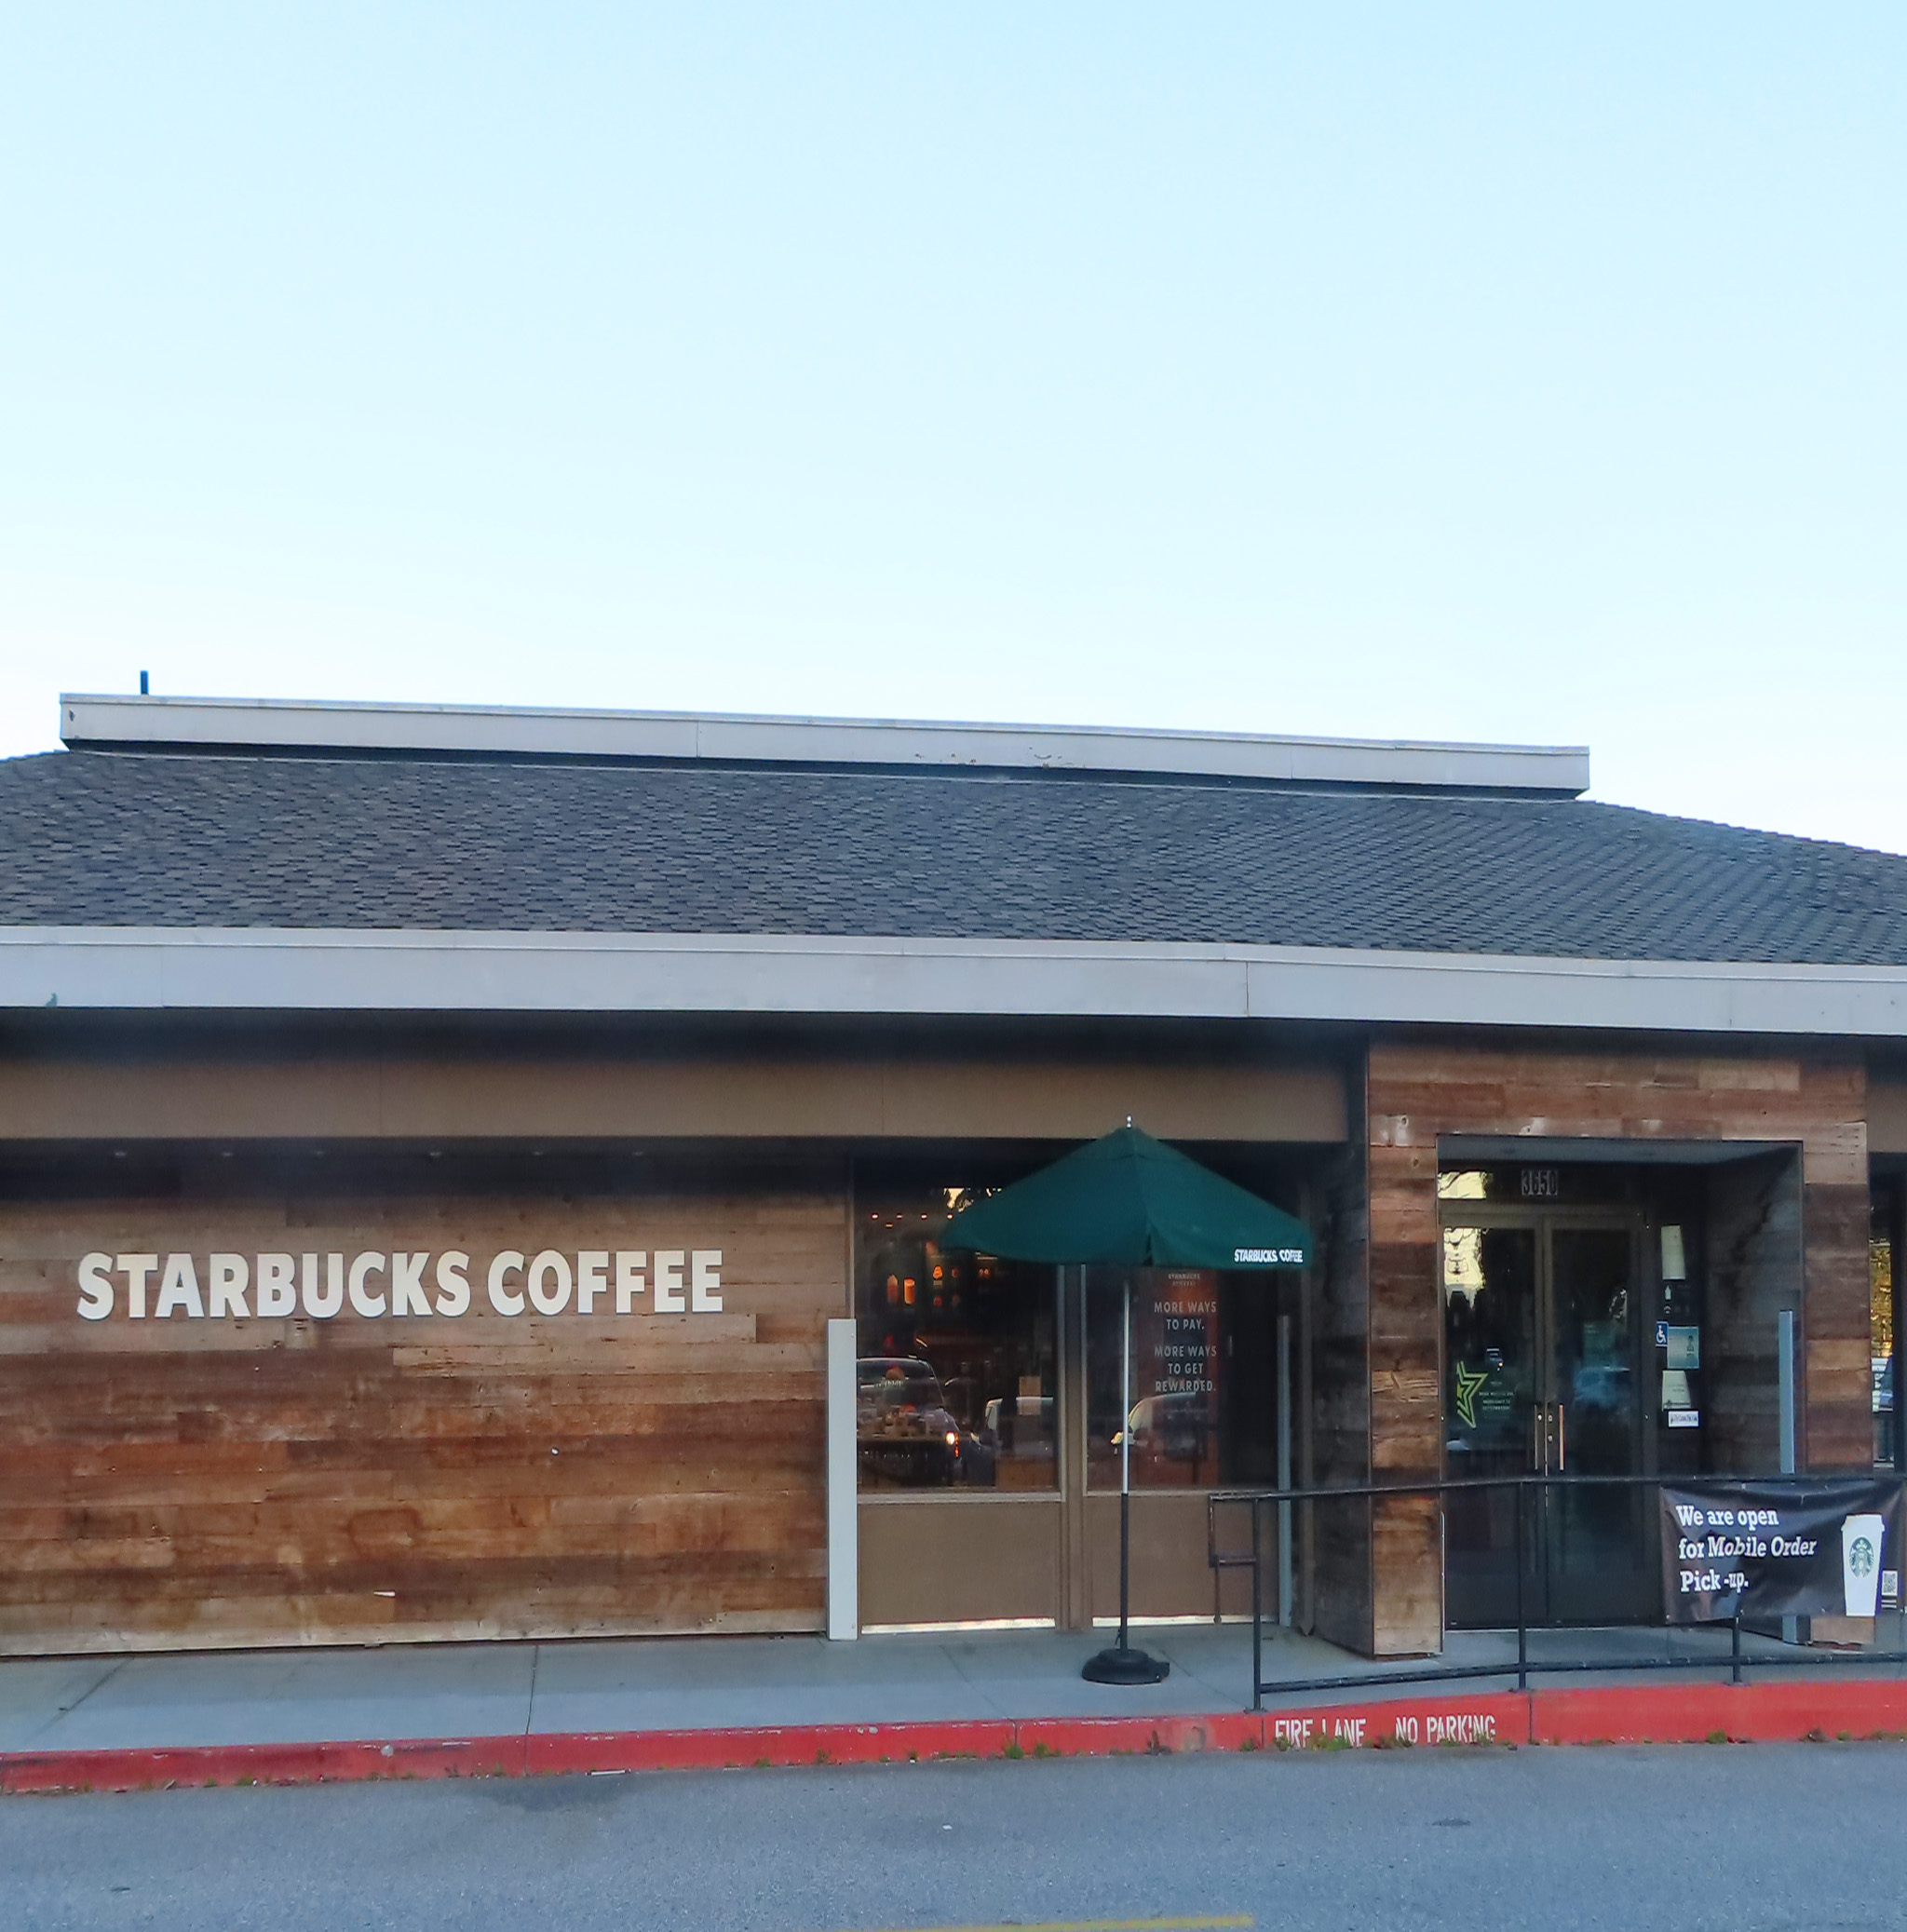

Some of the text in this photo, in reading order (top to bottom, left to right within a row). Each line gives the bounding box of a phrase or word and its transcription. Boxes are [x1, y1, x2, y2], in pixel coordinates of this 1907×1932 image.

[1234, 1248, 1278, 1263] STARBUCKS
[76, 1249, 724, 1320] STARBUCKS COFFEE
[1154, 1301, 1217, 1314] MORE WAYS
[1166, 1318, 1205, 1331] TO PAY.
[1154, 1345, 1217, 1358] MORE WAYS
[1168, 1362, 1204, 1374] TO GET
[1155, 1379, 1216, 1393] REWARDED.
[1676, 1506, 1779, 1532] We are open
[1679, 1536, 1817, 1560] for Mobile Order
[1395, 1714, 1496, 1744] NO PARKING
